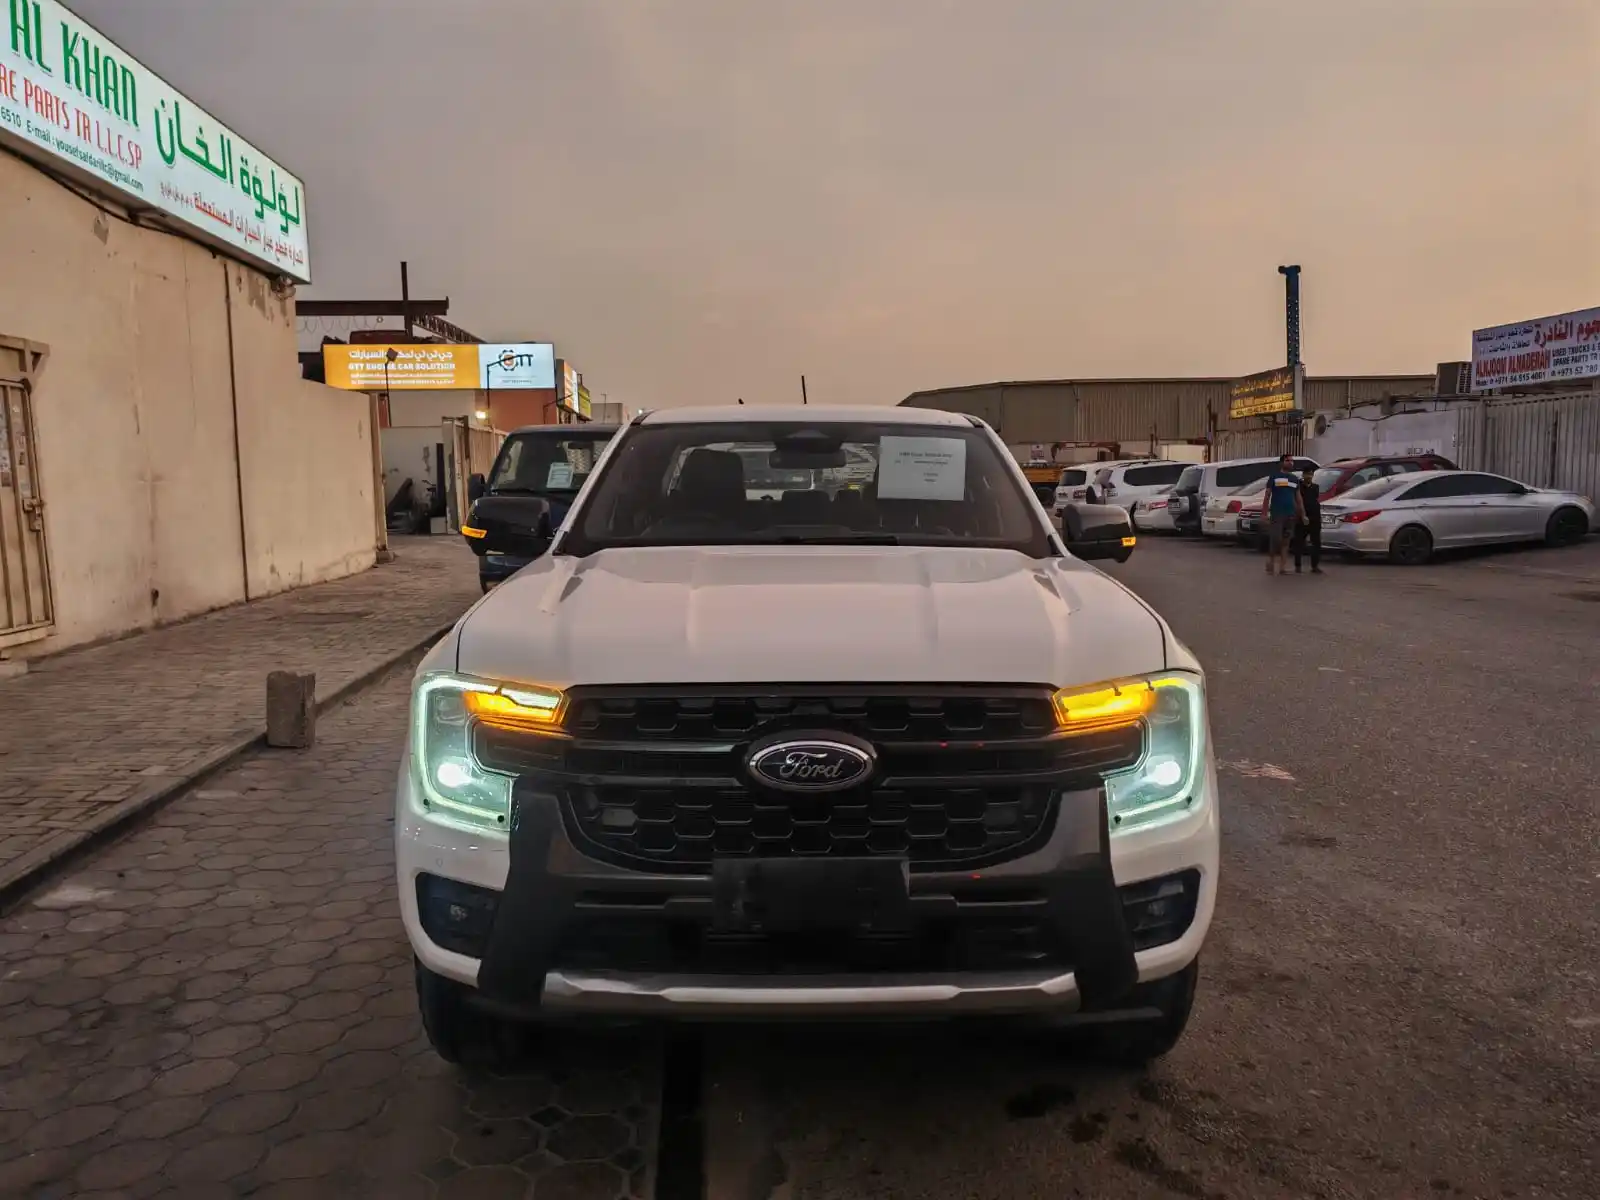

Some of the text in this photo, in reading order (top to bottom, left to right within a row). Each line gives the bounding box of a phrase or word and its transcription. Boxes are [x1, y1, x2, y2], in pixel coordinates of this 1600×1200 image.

[9, 0, 139, 127] AL KHAN
[24, 77, 70, 129] PARTS
[74, 107, 92, 143] TR
[154, 99, 300, 234] لؤلؤة الخان
[779, 751, 845, 778] Ford
